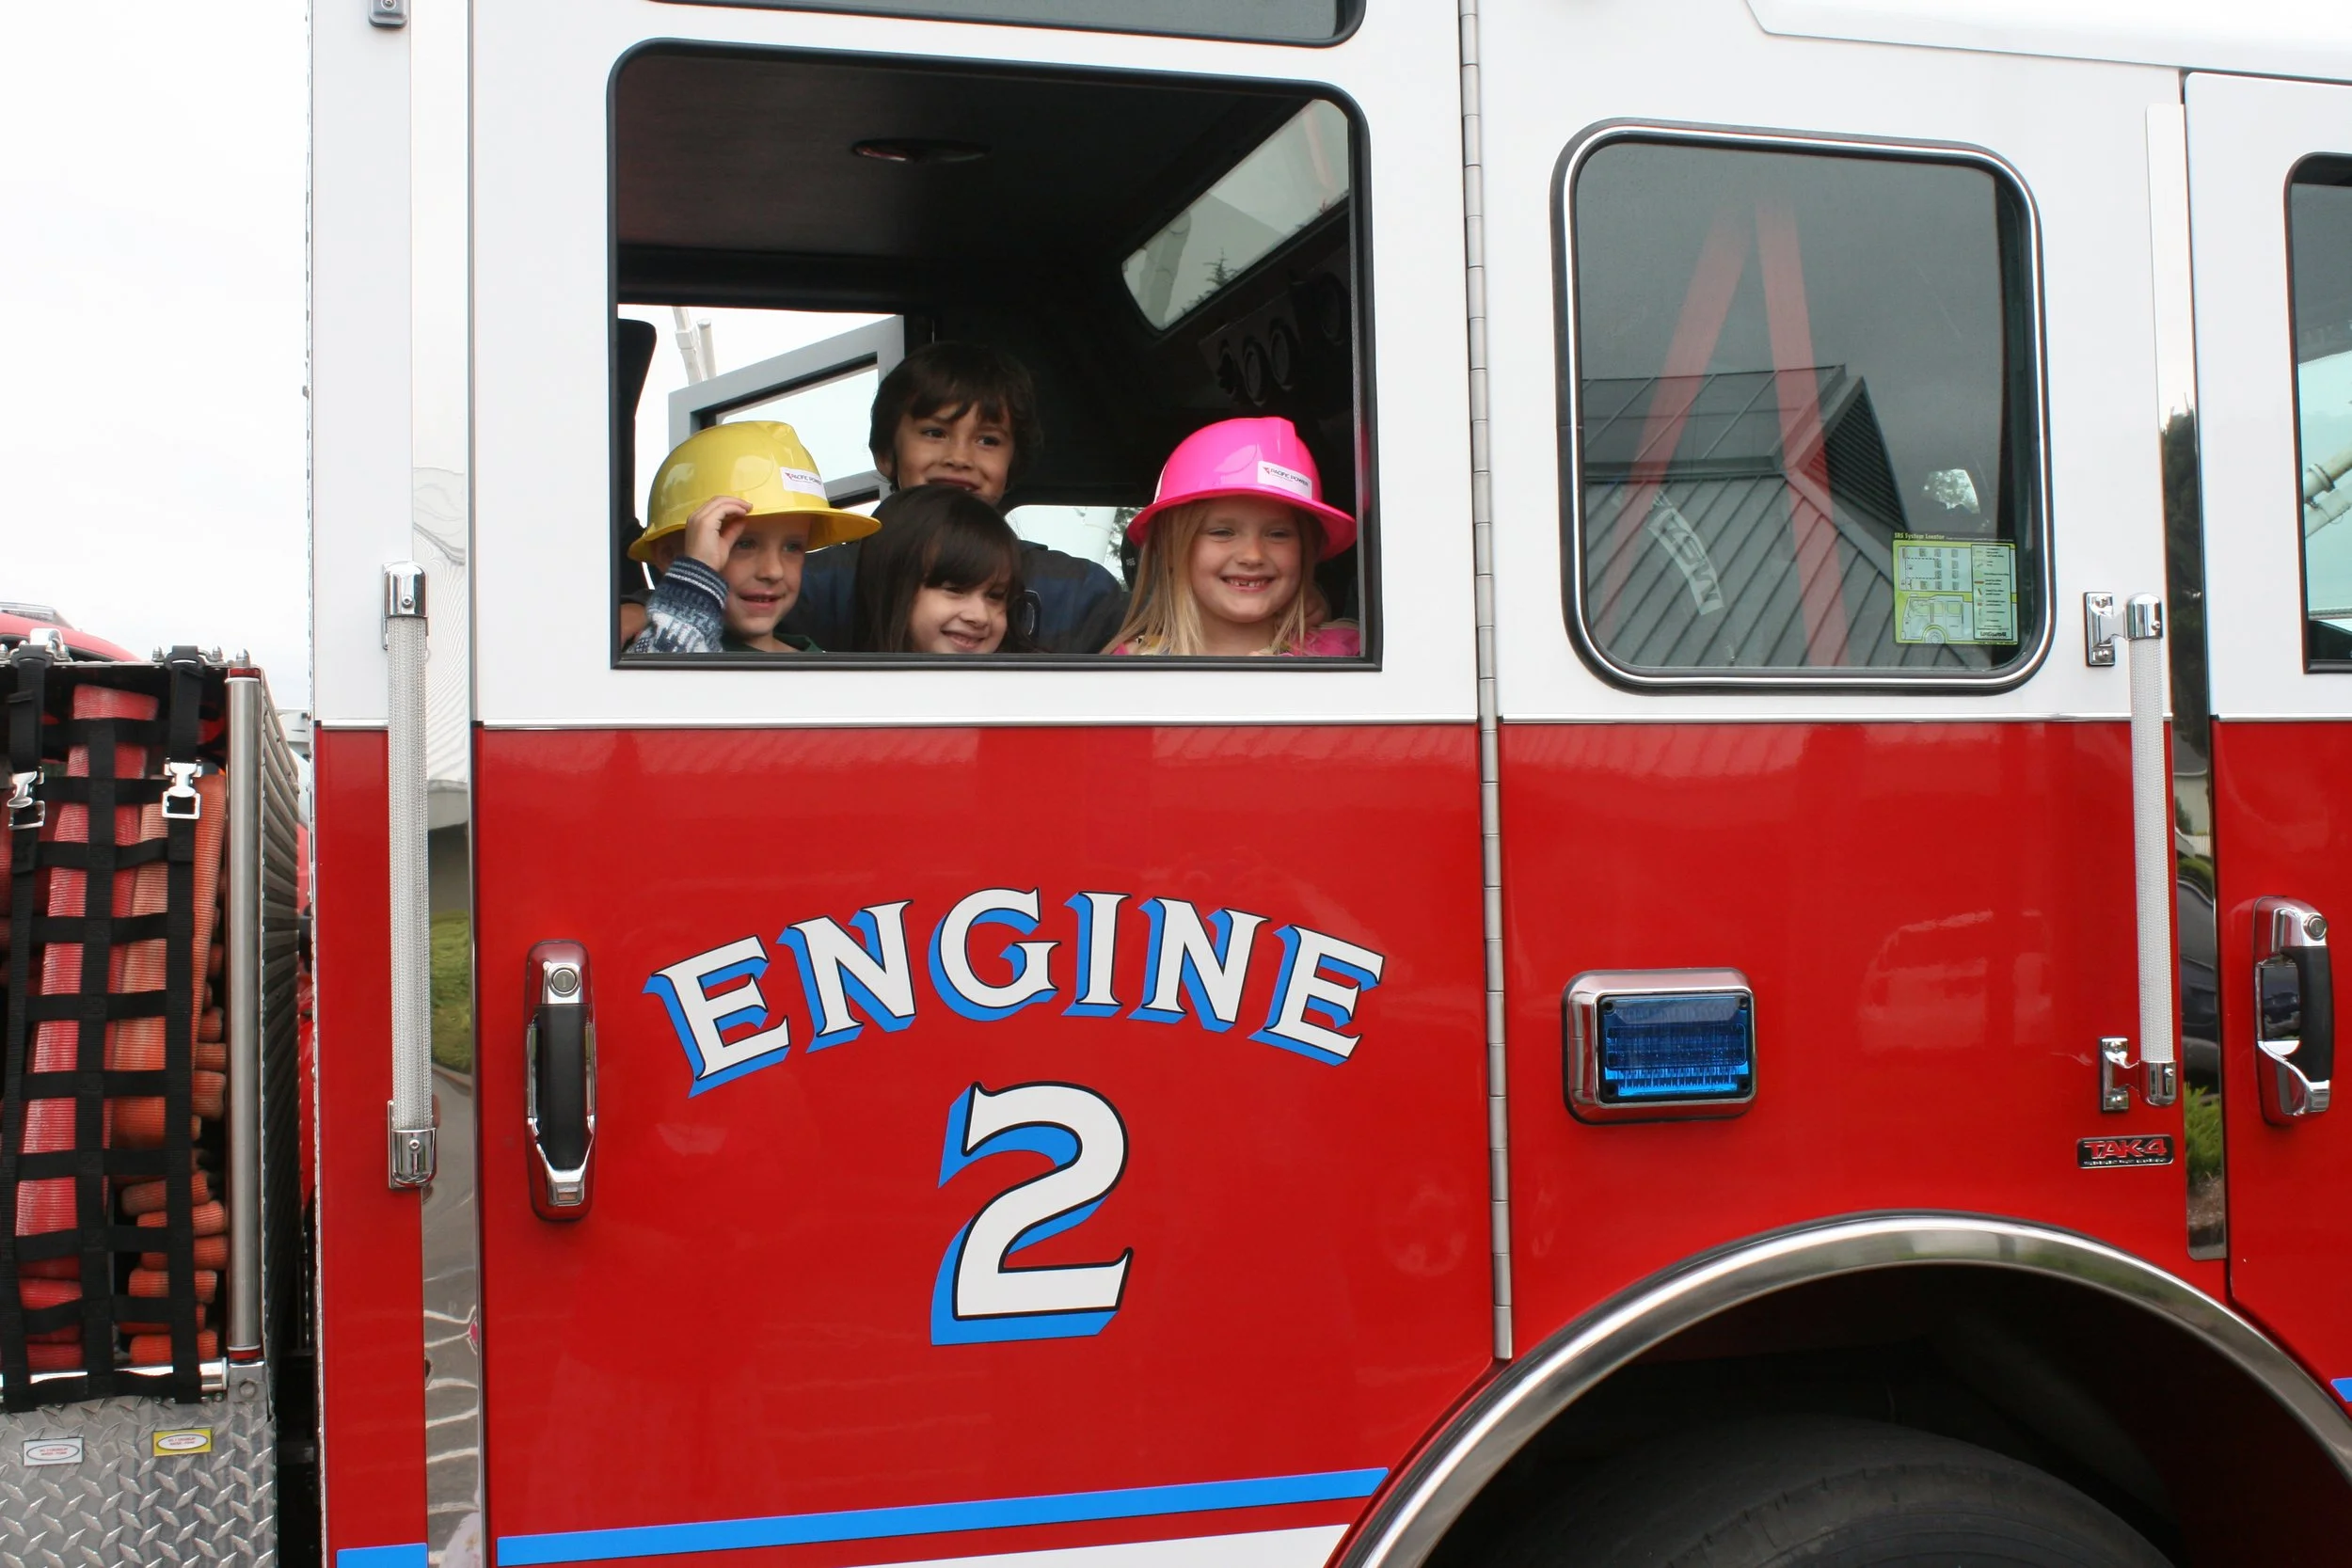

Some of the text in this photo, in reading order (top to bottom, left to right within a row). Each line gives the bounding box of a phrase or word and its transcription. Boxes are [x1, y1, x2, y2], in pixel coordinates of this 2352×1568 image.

[1290, 474, 1309, 487] POWER
[643, 887, 1385, 1099] ENGINE
[2084, 1138, 2168, 1160] TAK-4
[931, 1080, 1134, 1346] 2
